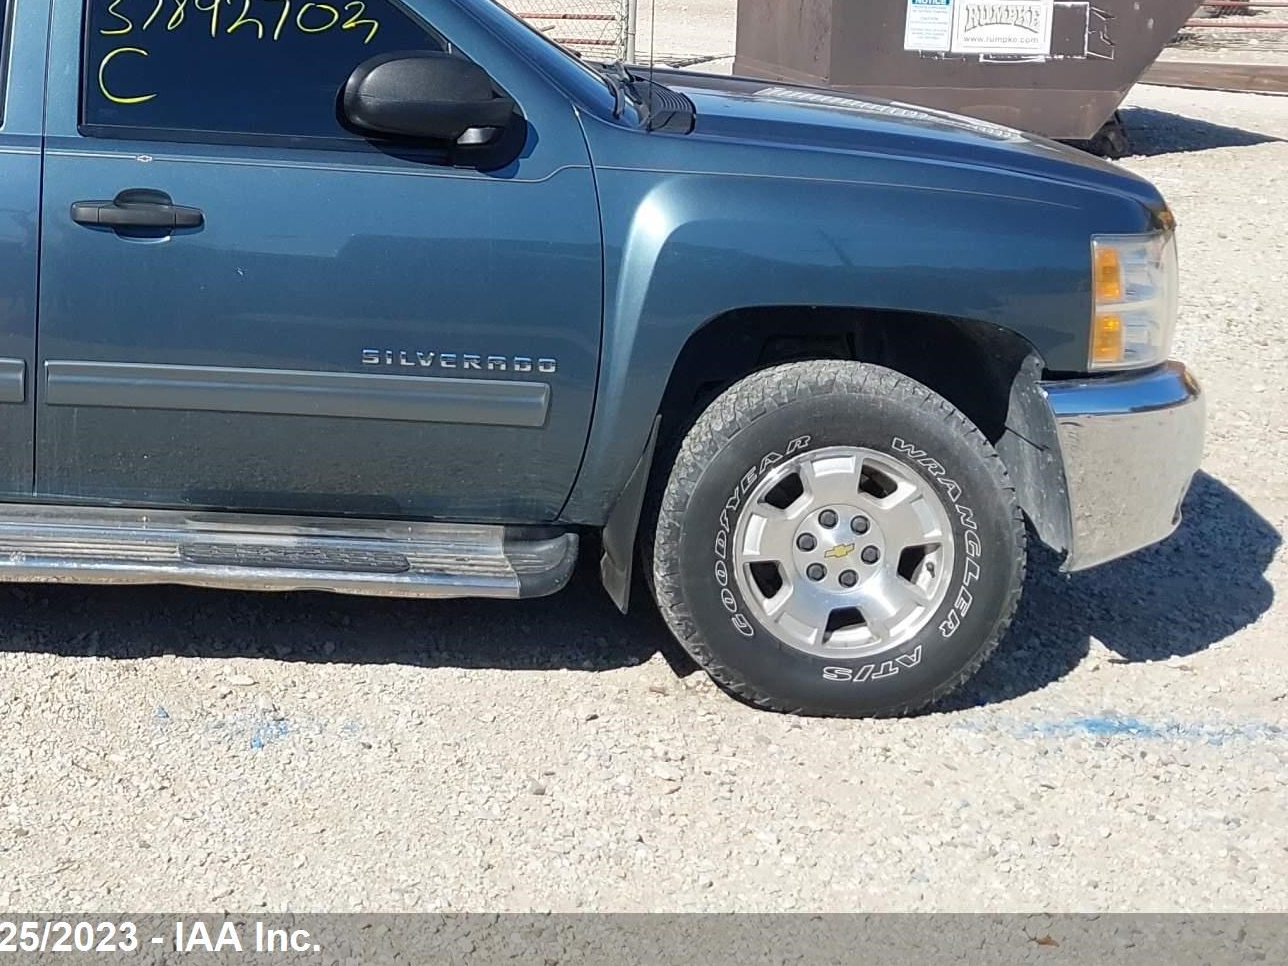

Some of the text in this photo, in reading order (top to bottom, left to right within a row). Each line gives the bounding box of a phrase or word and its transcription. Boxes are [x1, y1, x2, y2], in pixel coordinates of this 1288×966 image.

[99, 47, 157, 103] C
[362, 349, 557, 373] SILVERADO
[714, 435, 811, 637] GOODYEAR
[892, 437, 982, 638] WRANGLER
[823, 645, 922, 682] AT/S
